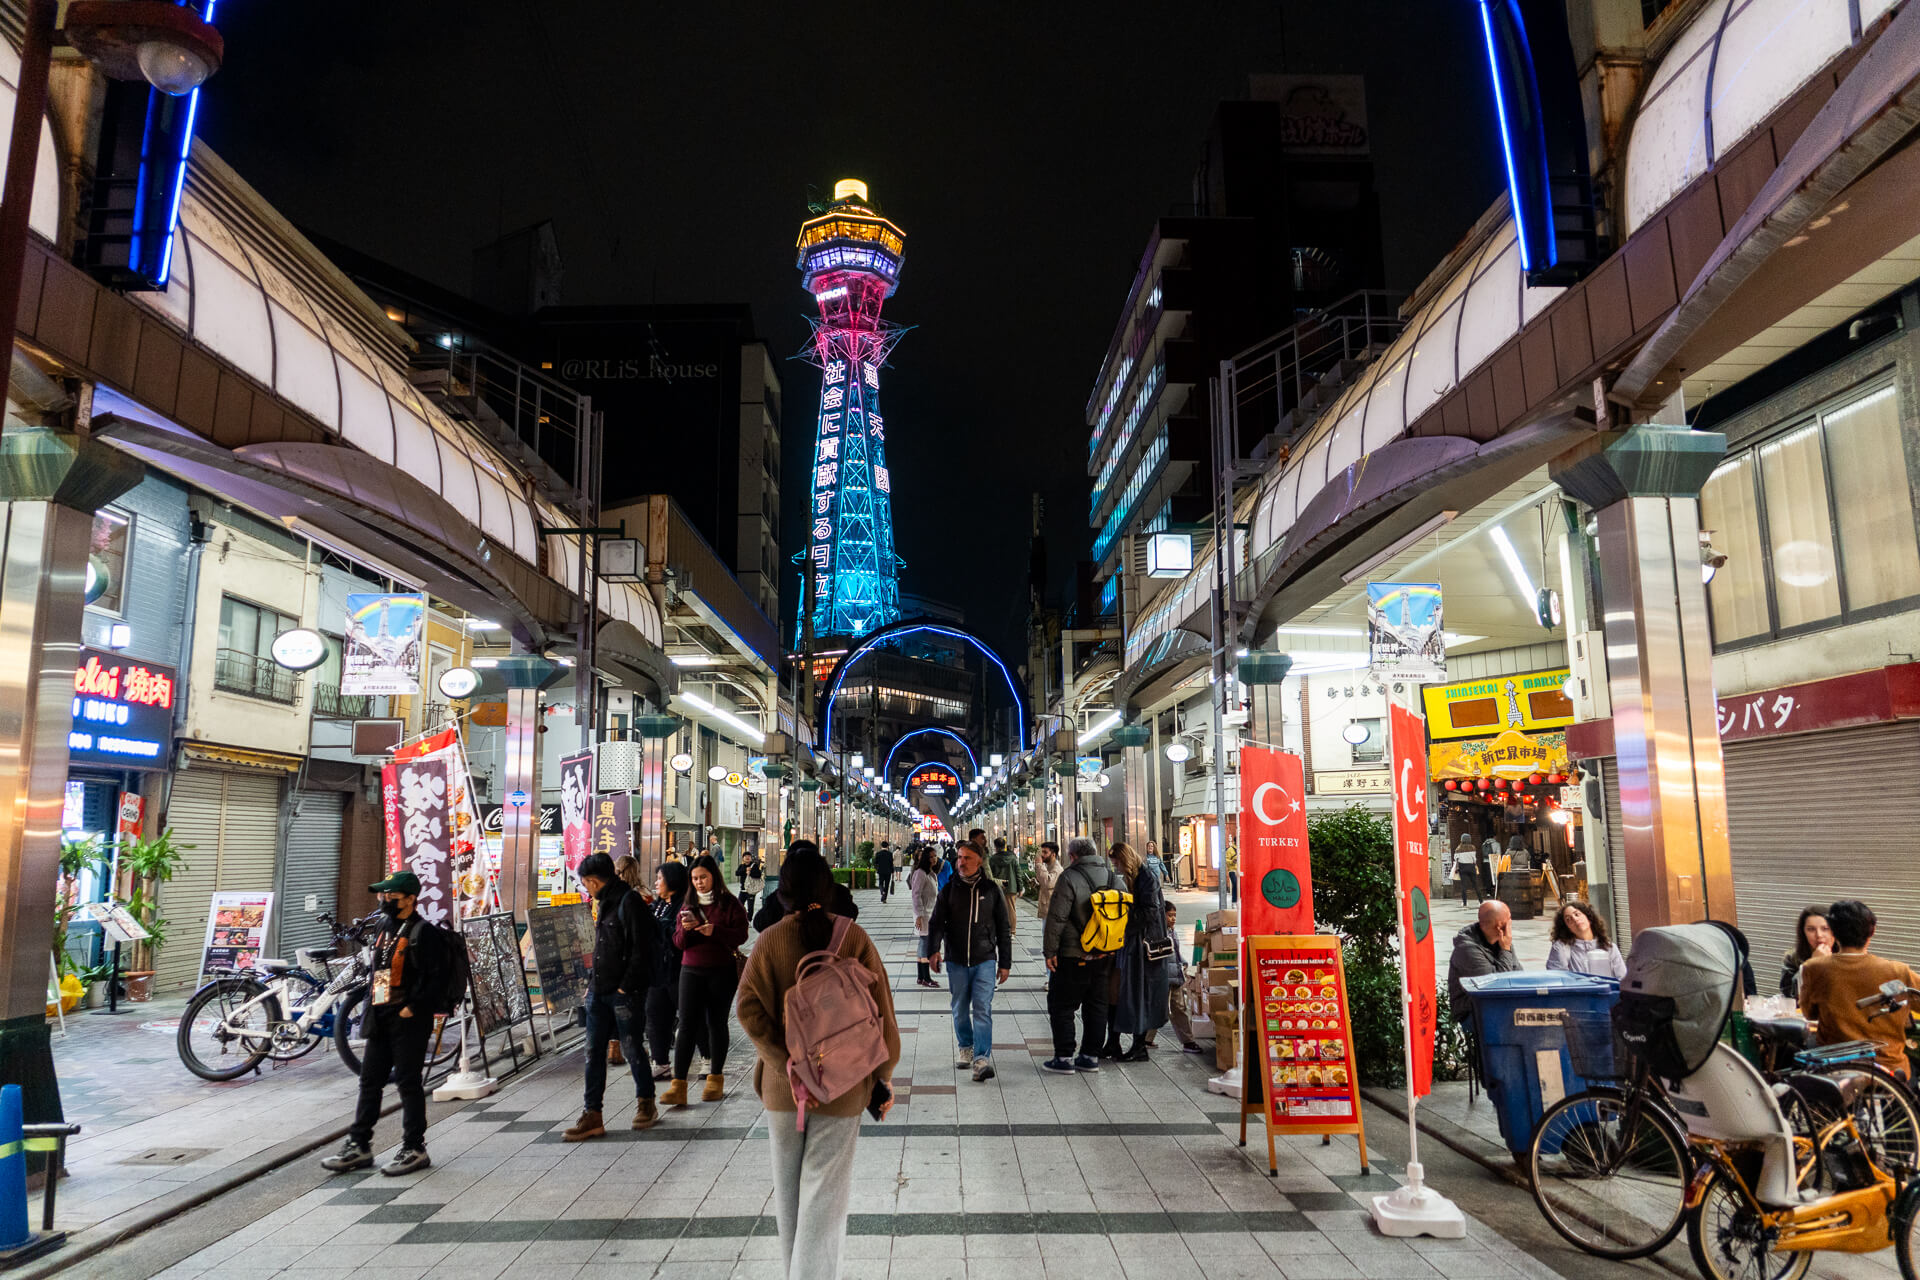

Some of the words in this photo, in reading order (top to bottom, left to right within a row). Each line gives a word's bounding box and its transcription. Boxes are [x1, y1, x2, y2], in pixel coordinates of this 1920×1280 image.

[816, 287, 847, 302] HITACHI
[864, 360, 890, 494] 通天閣
[811, 360, 845, 599] 社会に貢献する日立
[124, 665, 173, 709] 焼肉
[1444, 683, 1498, 699] SHINSEKAI
[1481, 745, 1547, 765] 新世界市場
[1258, 837, 1300, 848] TURKEY
[1265, 877, 1297, 894] حلال
[1272, 895, 1293, 903] HALAL
